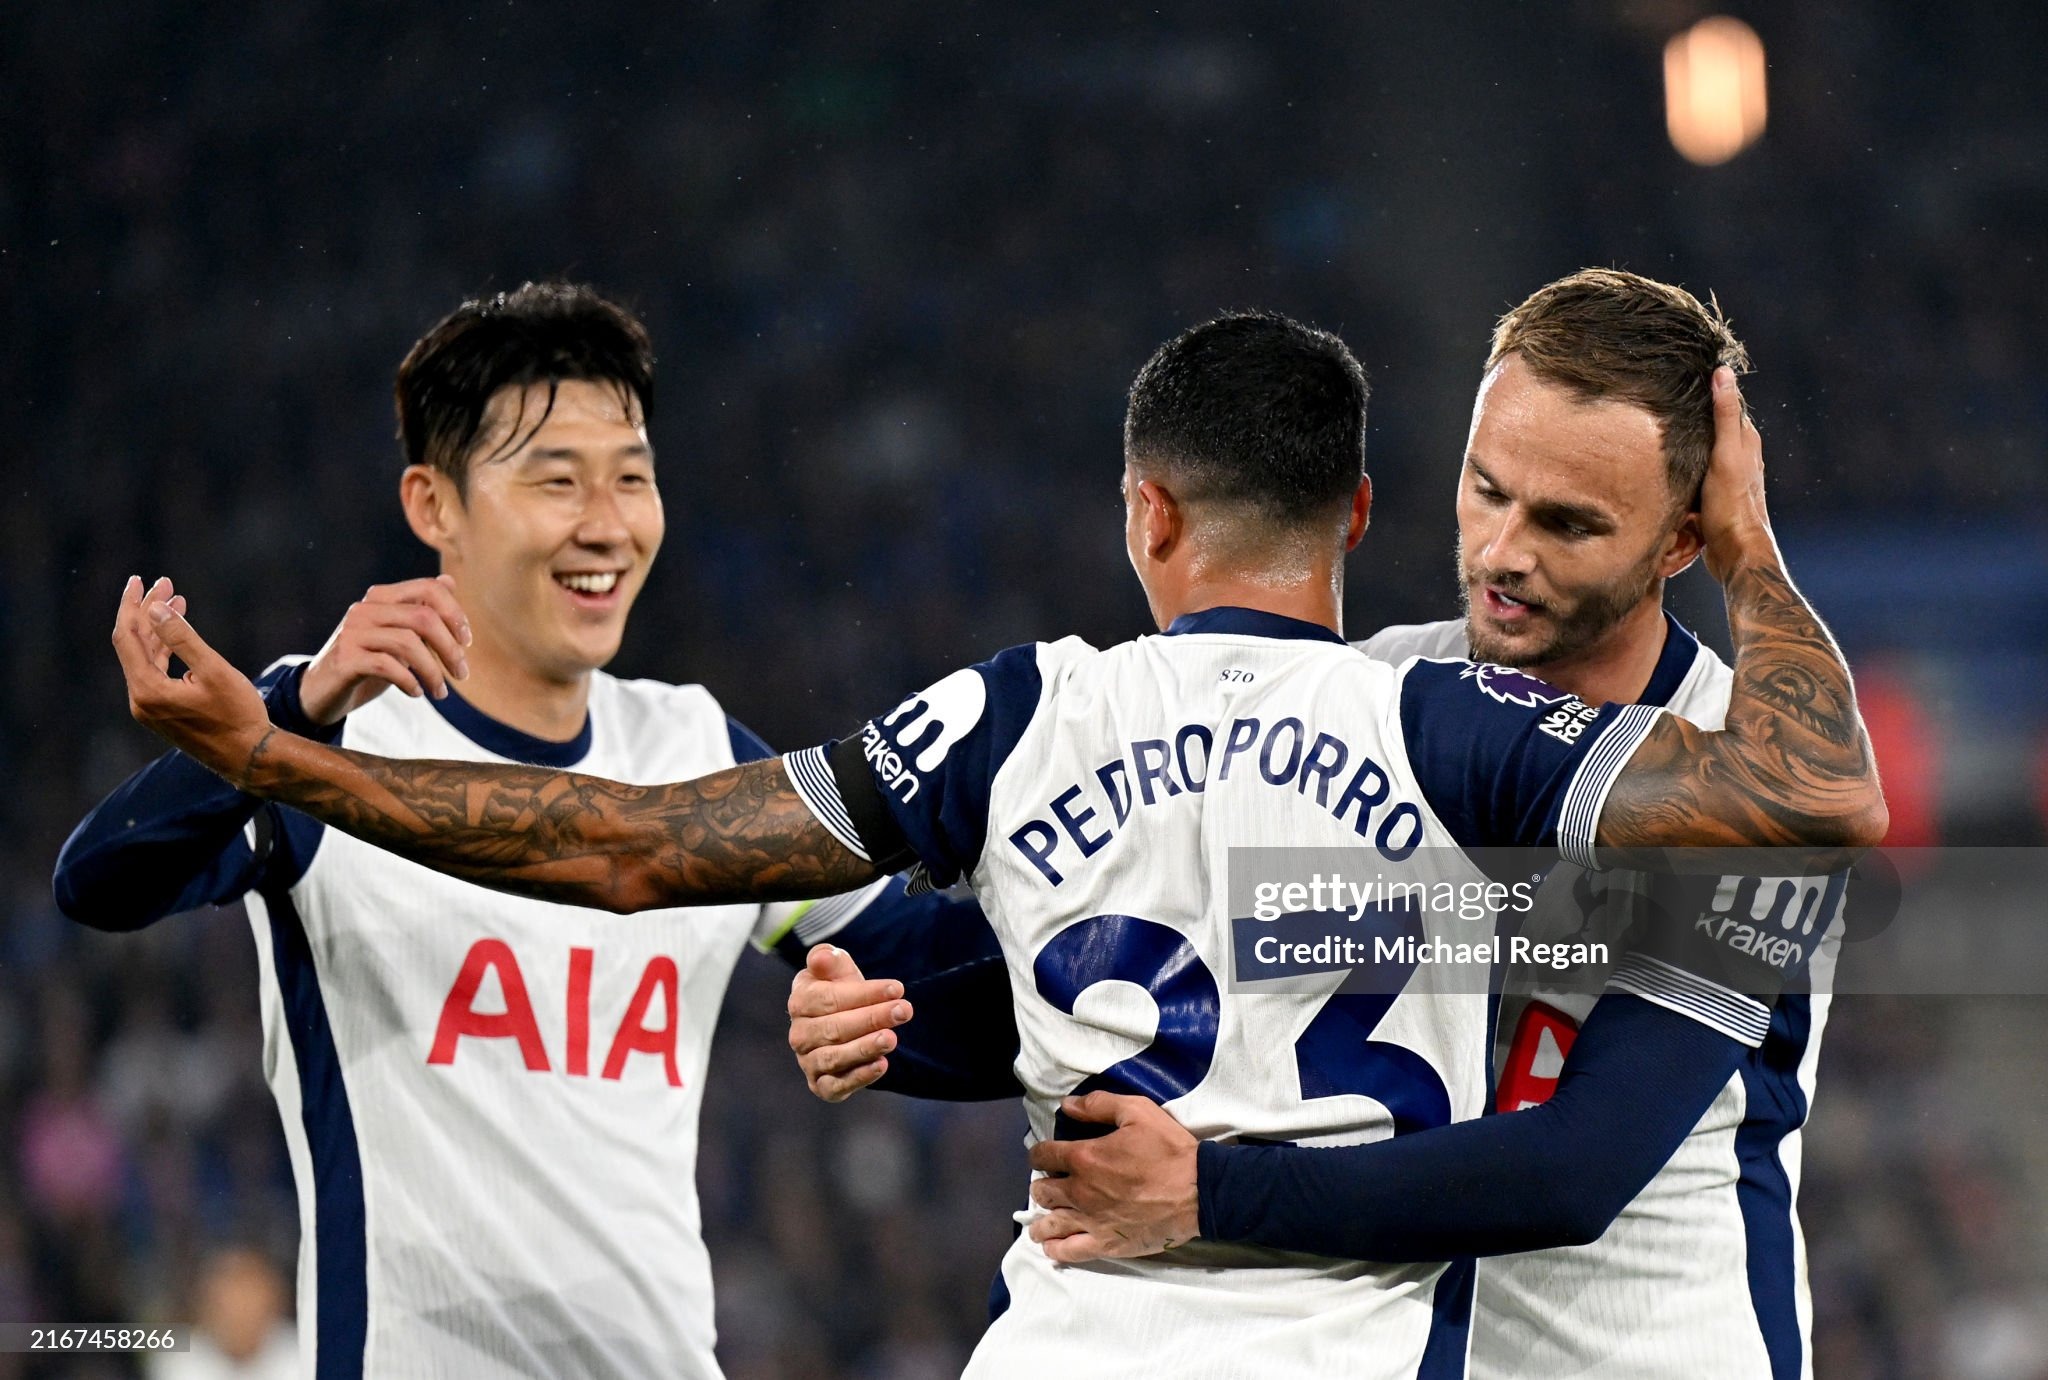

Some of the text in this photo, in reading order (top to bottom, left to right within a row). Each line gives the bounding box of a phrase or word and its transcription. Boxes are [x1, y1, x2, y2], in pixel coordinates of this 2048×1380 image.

[1218, 668, 1255, 684] 870
[1539, 711, 1570, 737] No
[1008, 717, 1424, 888] PEDRO PORRO
[1694, 912, 1803, 968] kraken
[426, 936, 684, 1088] AIA
